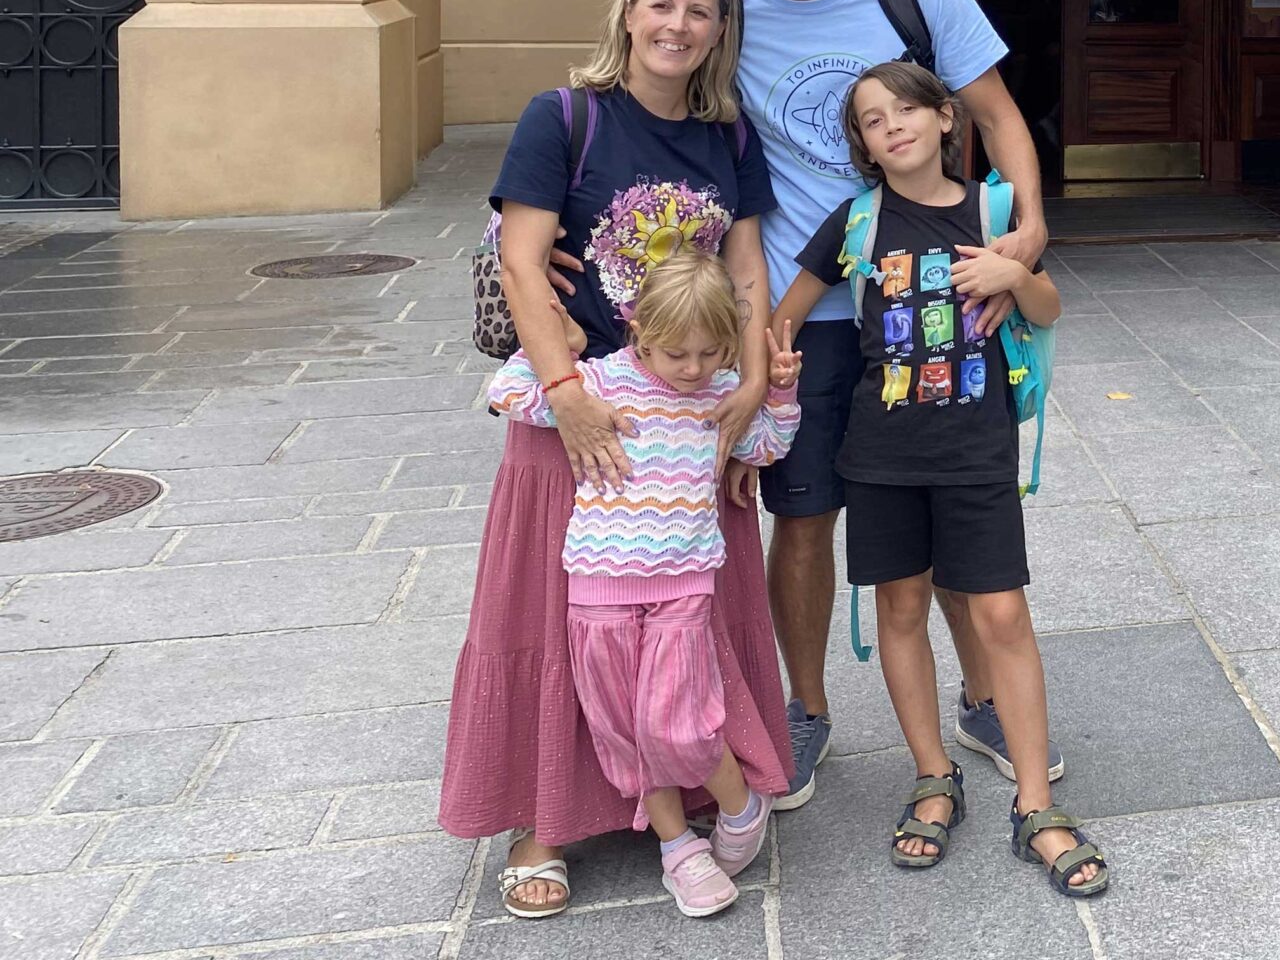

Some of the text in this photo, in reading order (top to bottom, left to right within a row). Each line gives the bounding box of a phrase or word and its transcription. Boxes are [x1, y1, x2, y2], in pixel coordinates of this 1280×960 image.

[786, 58, 868, 85] TO INFINITY
[798, 151, 827, 170] AND
